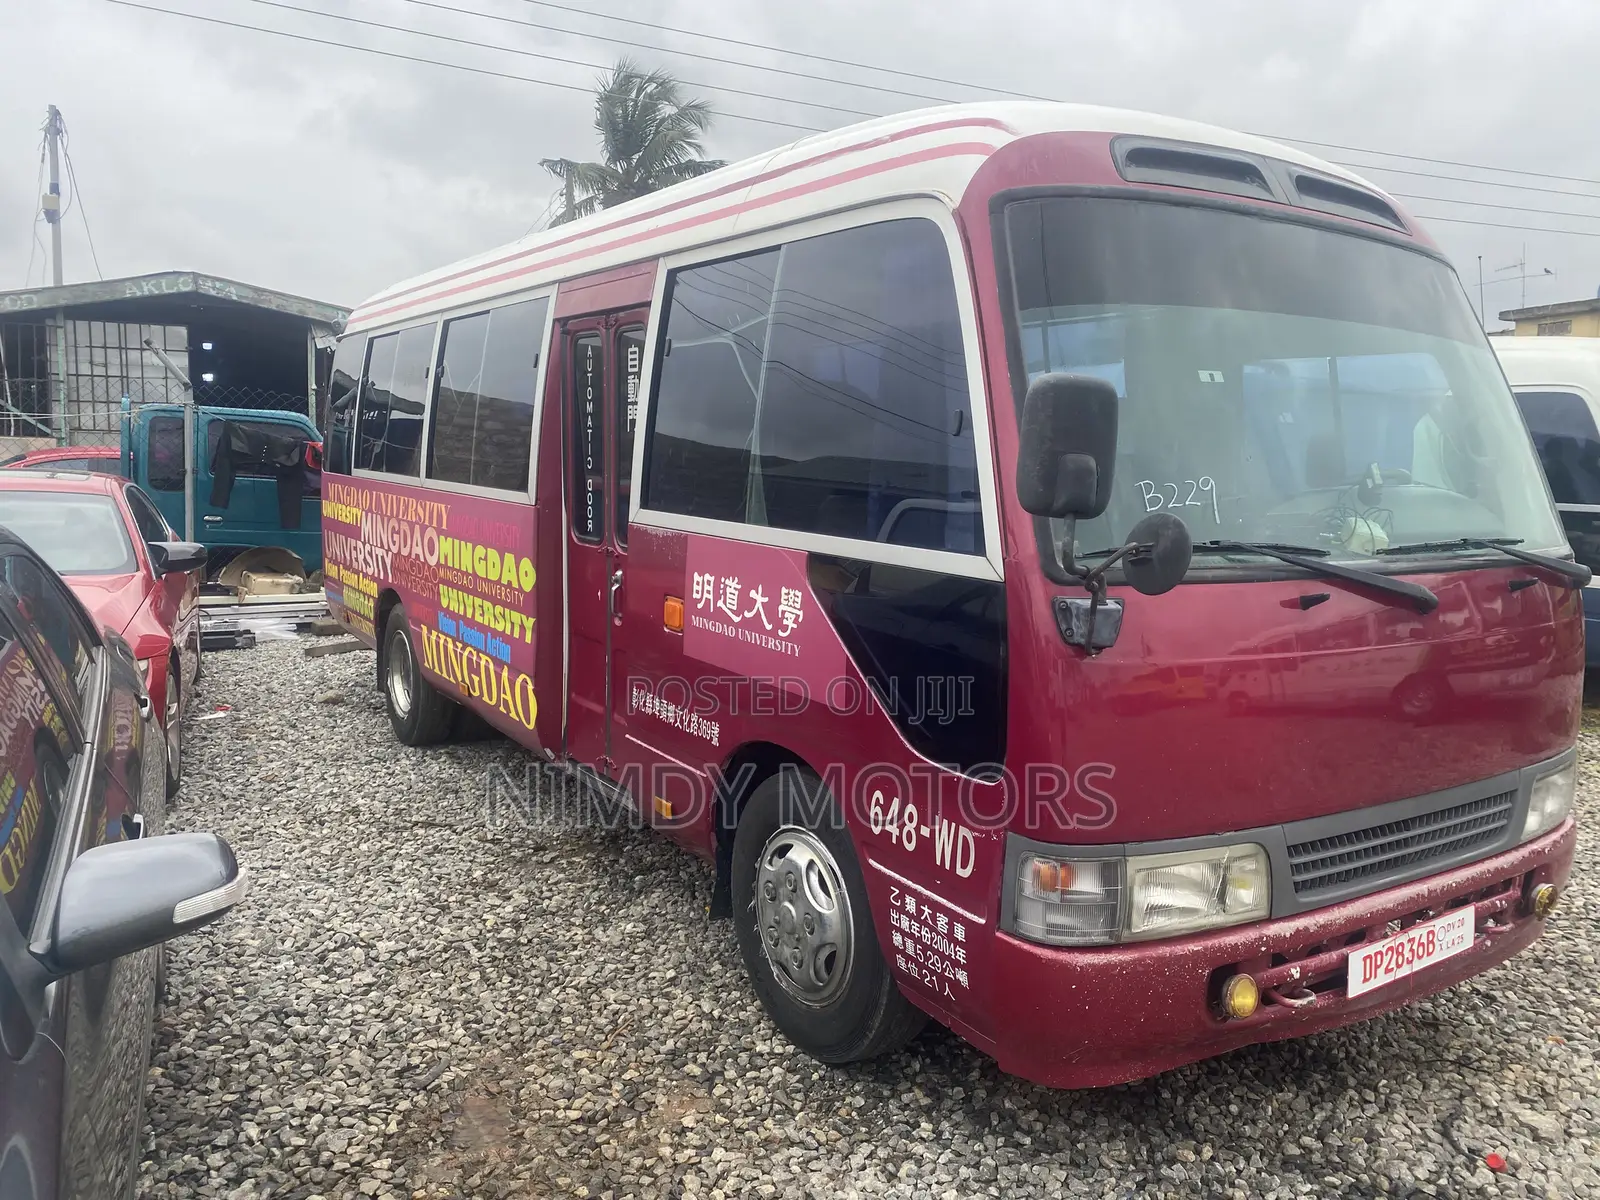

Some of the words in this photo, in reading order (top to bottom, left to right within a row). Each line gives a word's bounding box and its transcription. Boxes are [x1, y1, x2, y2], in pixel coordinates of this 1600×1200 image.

[322, 500, 362, 527] UNIVERSITY
[328, 482, 370, 511] MINGDAO
[372, 491, 450, 530] UNIVERSITY
[1134, 476, 1220, 524] B229
[324, 529, 393, 584] UNIVERSITY
[361, 511, 439, 566] MINGDAO
[439, 535, 536, 593] MINGDAO
[392, 554, 439, 584] MINGDAO
[392, 569, 438, 601] UNIVERSITY
[439, 567, 474, 589] MINGDAO
[476, 579, 524, 606] UNIVERSITY
[439, 584, 536, 644] UNIVERSITY
[692, 572, 803, 637] 明道大學
[438, 610, 456, 638] Vision
[459, 620, 485, 651] Passion
[486, 632, 511, 664] Action
[691, 615, 735, 637] MINGDAO
[738, 629, 801, 657] UNIVERSITY
[420, 624, 537, 730] MINGDAO
[870, 790, 975, 878] 648-WD
[1362, 929, 1435, 984] DP2836B
